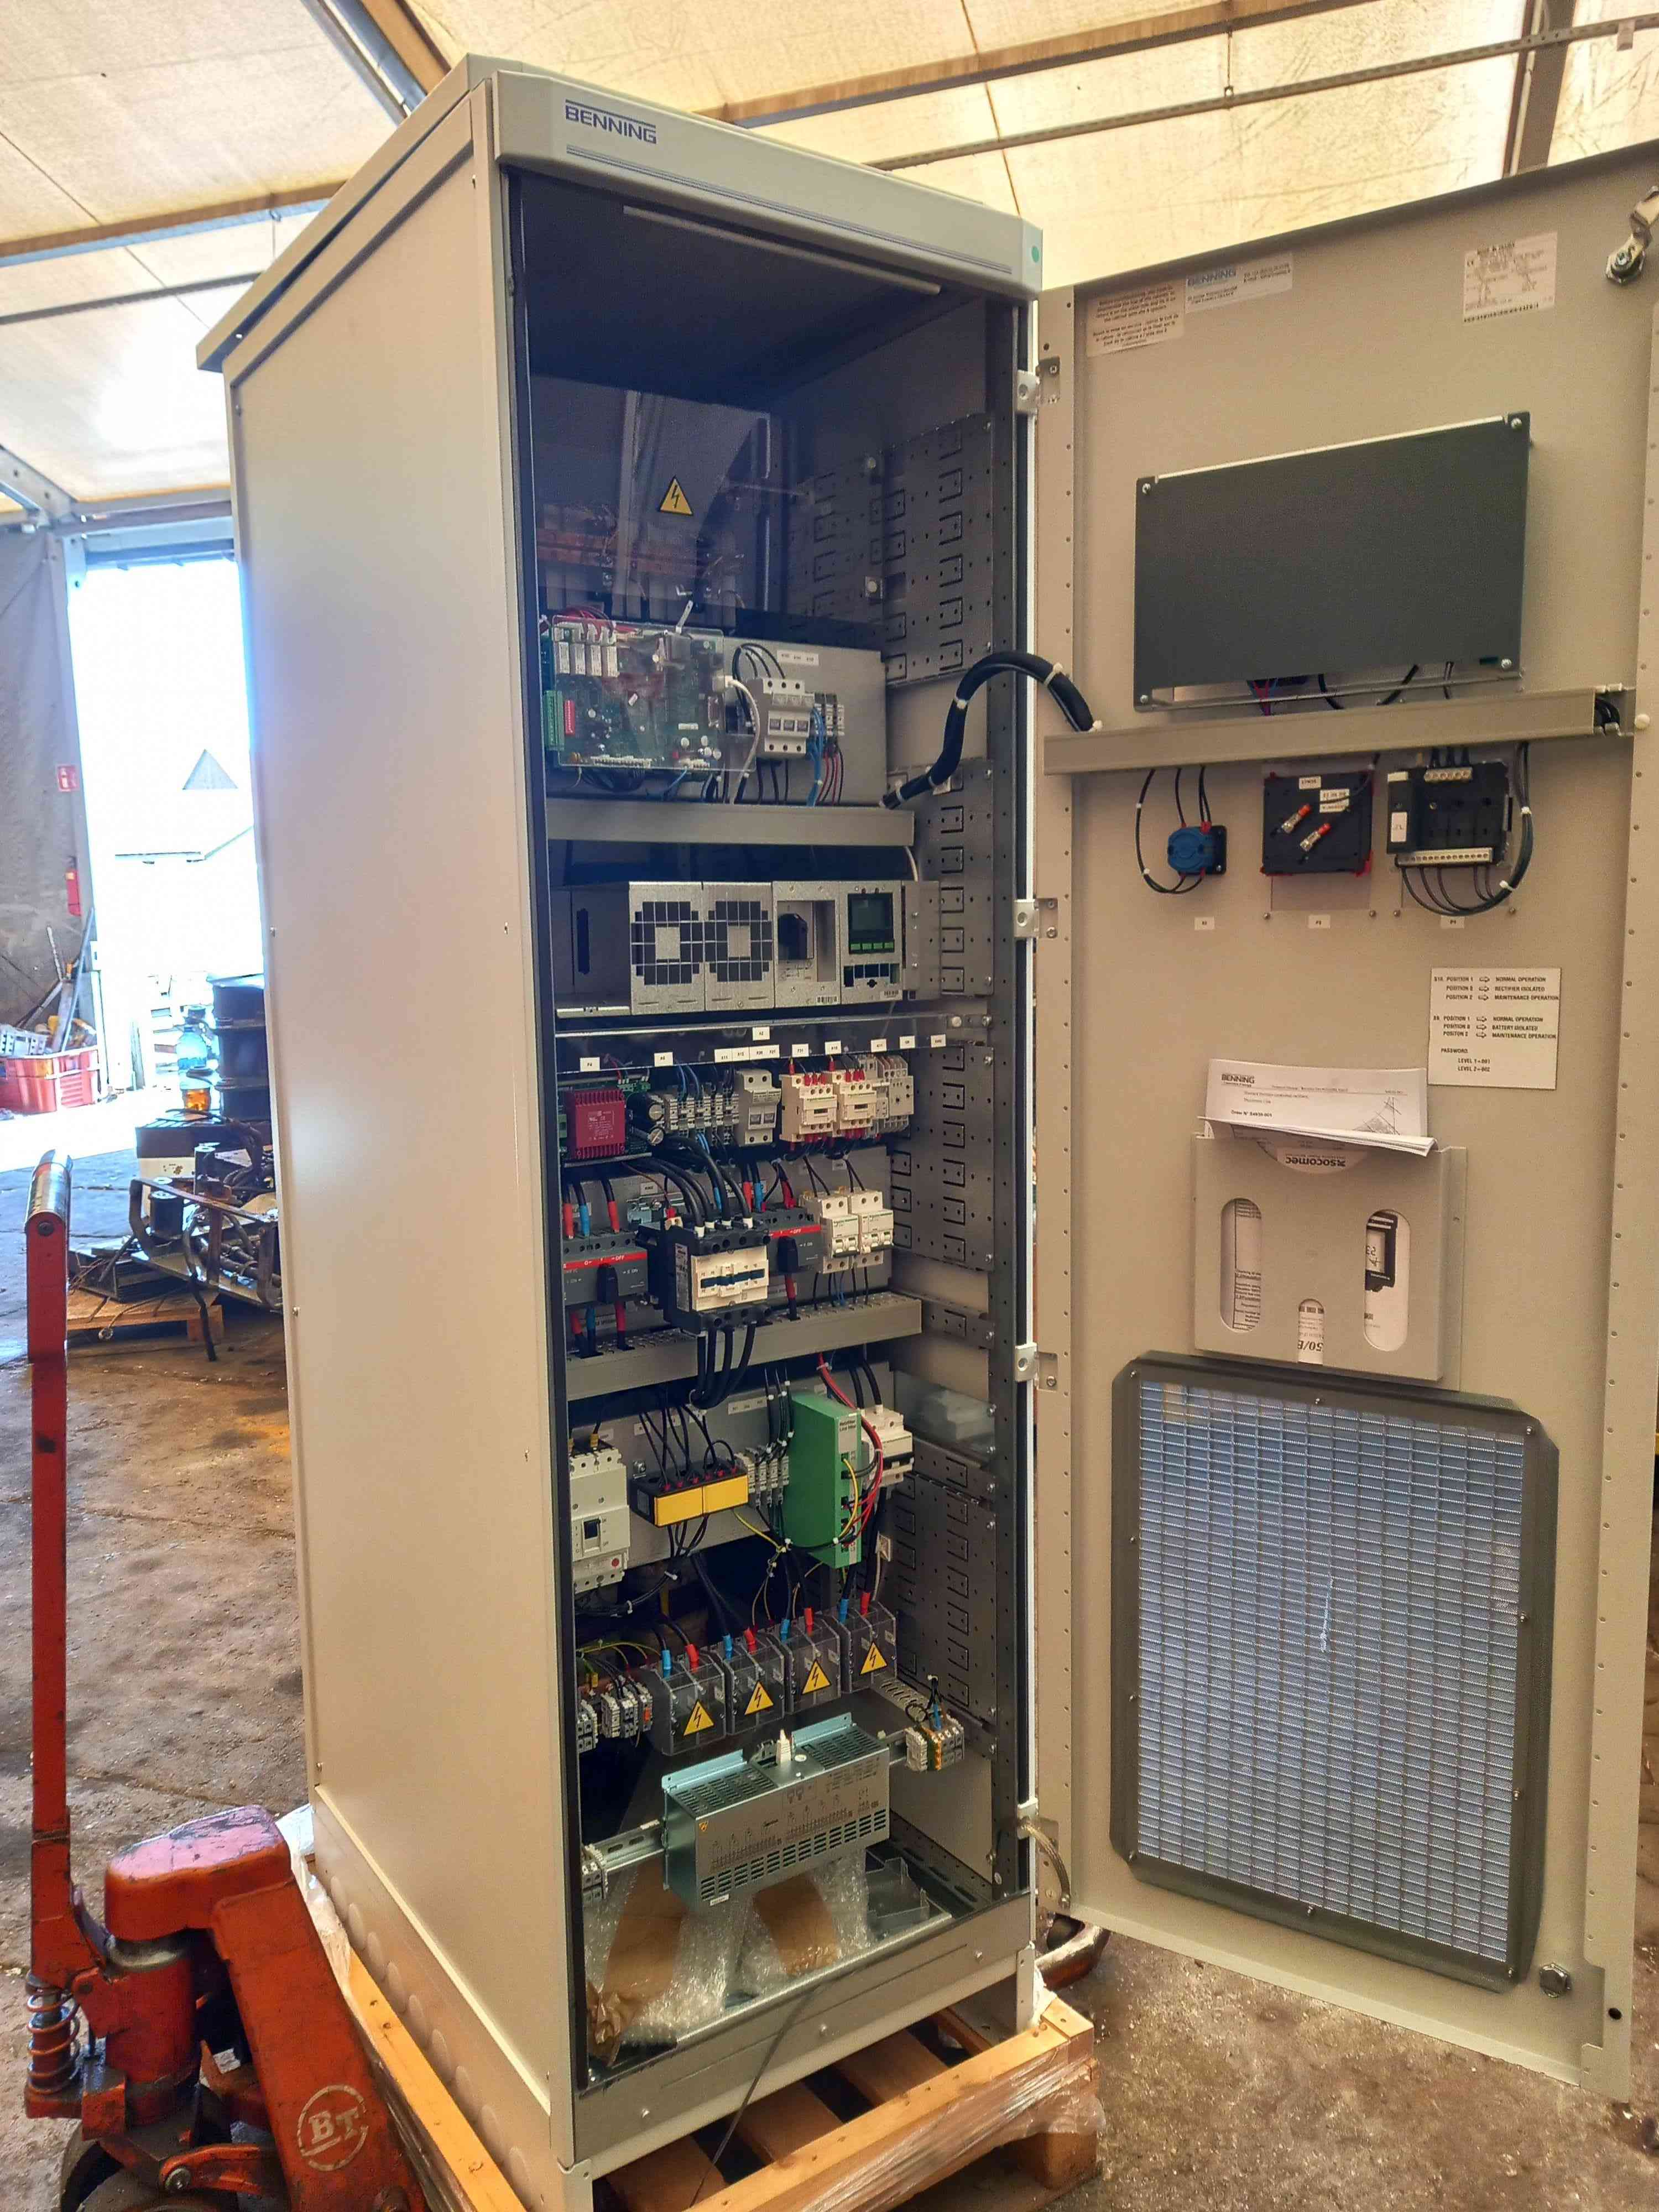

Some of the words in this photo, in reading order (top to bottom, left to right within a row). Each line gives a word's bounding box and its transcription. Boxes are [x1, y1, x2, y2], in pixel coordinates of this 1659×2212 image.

[565, 104, 656, 144] BENNING
[1221, 1074, 1255, 1084] BENNING
[1286, 1156, 1336, 1166] socomec
[309, 2109, 359, 2145] BT
